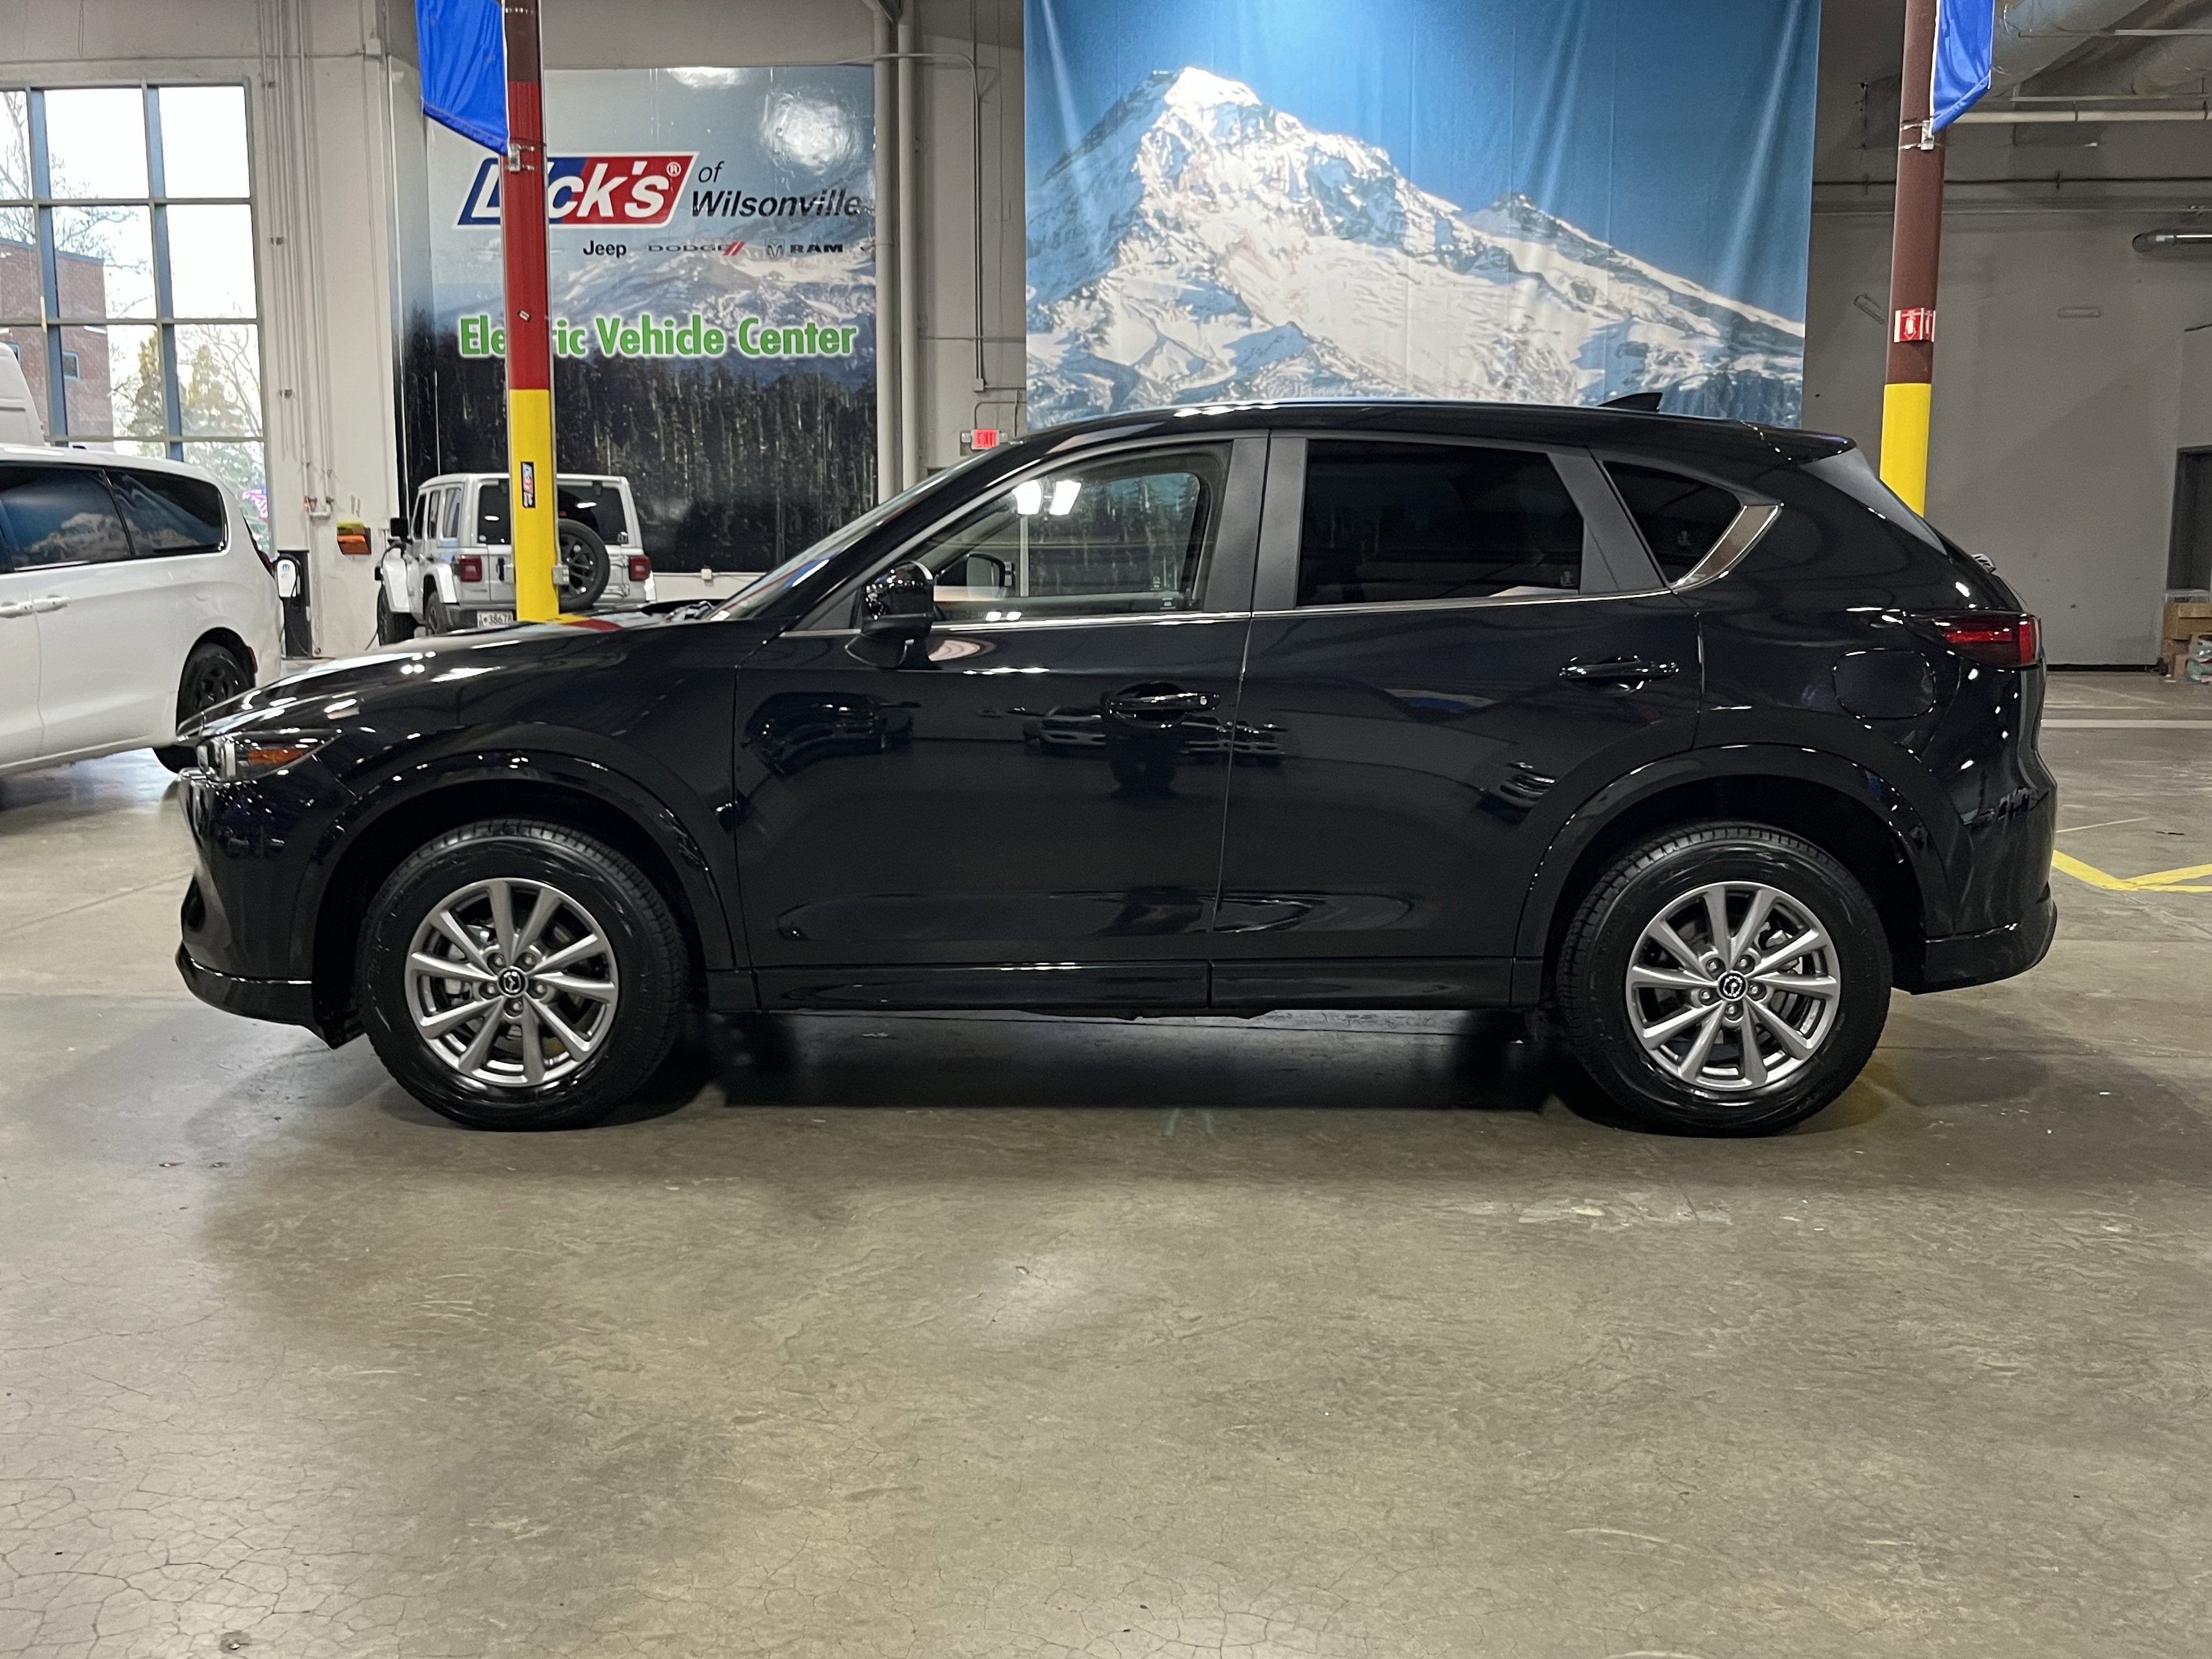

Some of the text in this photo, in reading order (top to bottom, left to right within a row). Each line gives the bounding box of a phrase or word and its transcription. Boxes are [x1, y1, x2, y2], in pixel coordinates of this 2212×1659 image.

[698, 161, 724, 183] of
[692, 190, 863, 217] Wilsonville
[583, 240, 627, 258] Jeep
[790, 244, 843, 253] RAM
[596, 314, 724, 356] Vehicle
[739, 317, 857, 356] Center
[976, 431, 996, 447] EXIT
